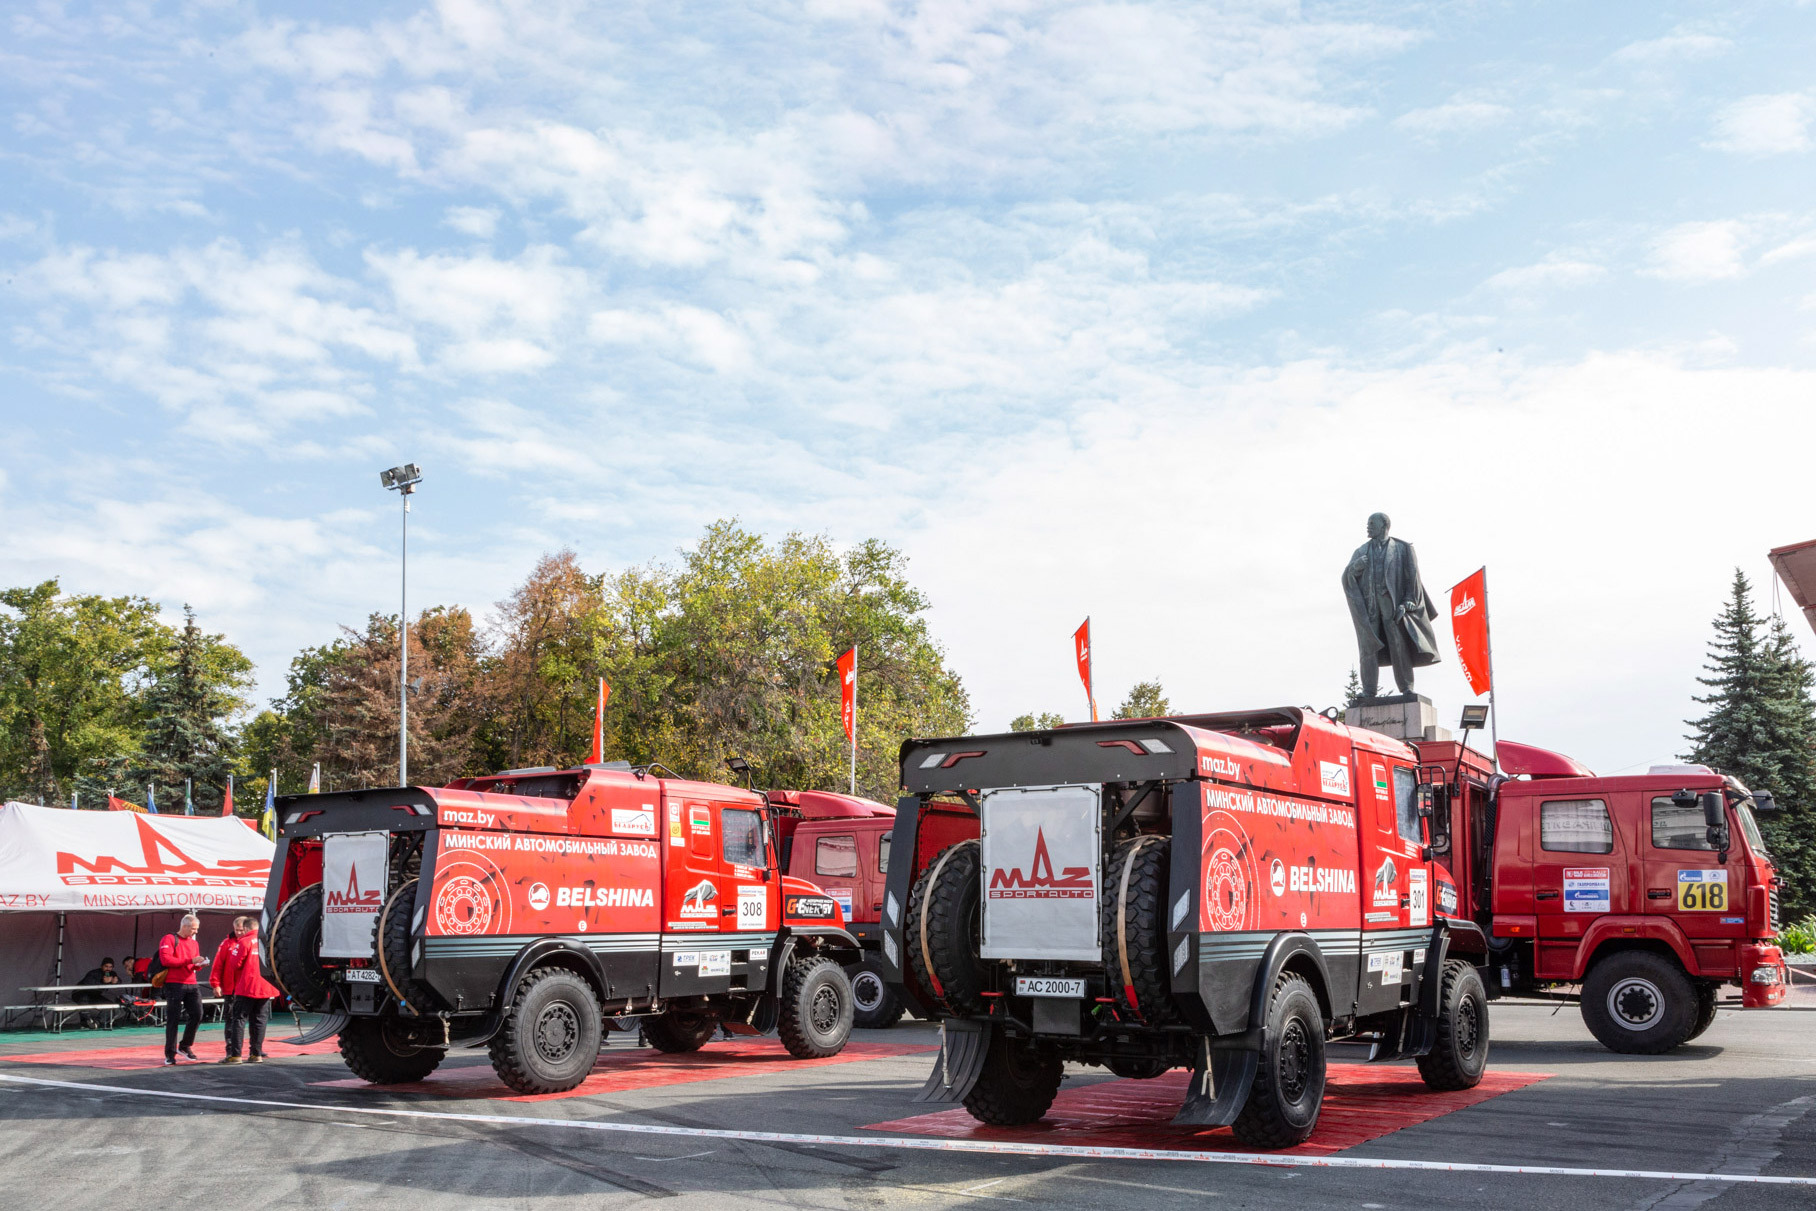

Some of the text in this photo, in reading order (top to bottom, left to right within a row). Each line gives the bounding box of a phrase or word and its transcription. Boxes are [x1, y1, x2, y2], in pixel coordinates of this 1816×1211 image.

[1202, 756, 1240, 780] maz.by
[443, 809, 495, 827] maz.by
[1206, 789, 1354, 829] МИНСКИЙ АВТОМОБИЛЬНЫЙ ЗАВОД
[56, 812, 273, 879] MAZ
[445, 834, 657, 858] МИНСКИЙ АВТОМОБИЛЬНЫЙ ЗАВОД
[989, 824, 1094, 888] MAZ
[327, 860, 381, 906] MAZ
[1290, 866, 1356, 893] BELSHINA
[84, 893, 264, 907] MINSK AUTOMOBILE P
[556, 887, 654, 907] BELSHINA
[1412, 889, 1425, 909] 301
[1683, 883, 1724, 909] 618
[742, 901, 762, 917] 308
[1027, 981, 1081, 994] AC 2000-7
